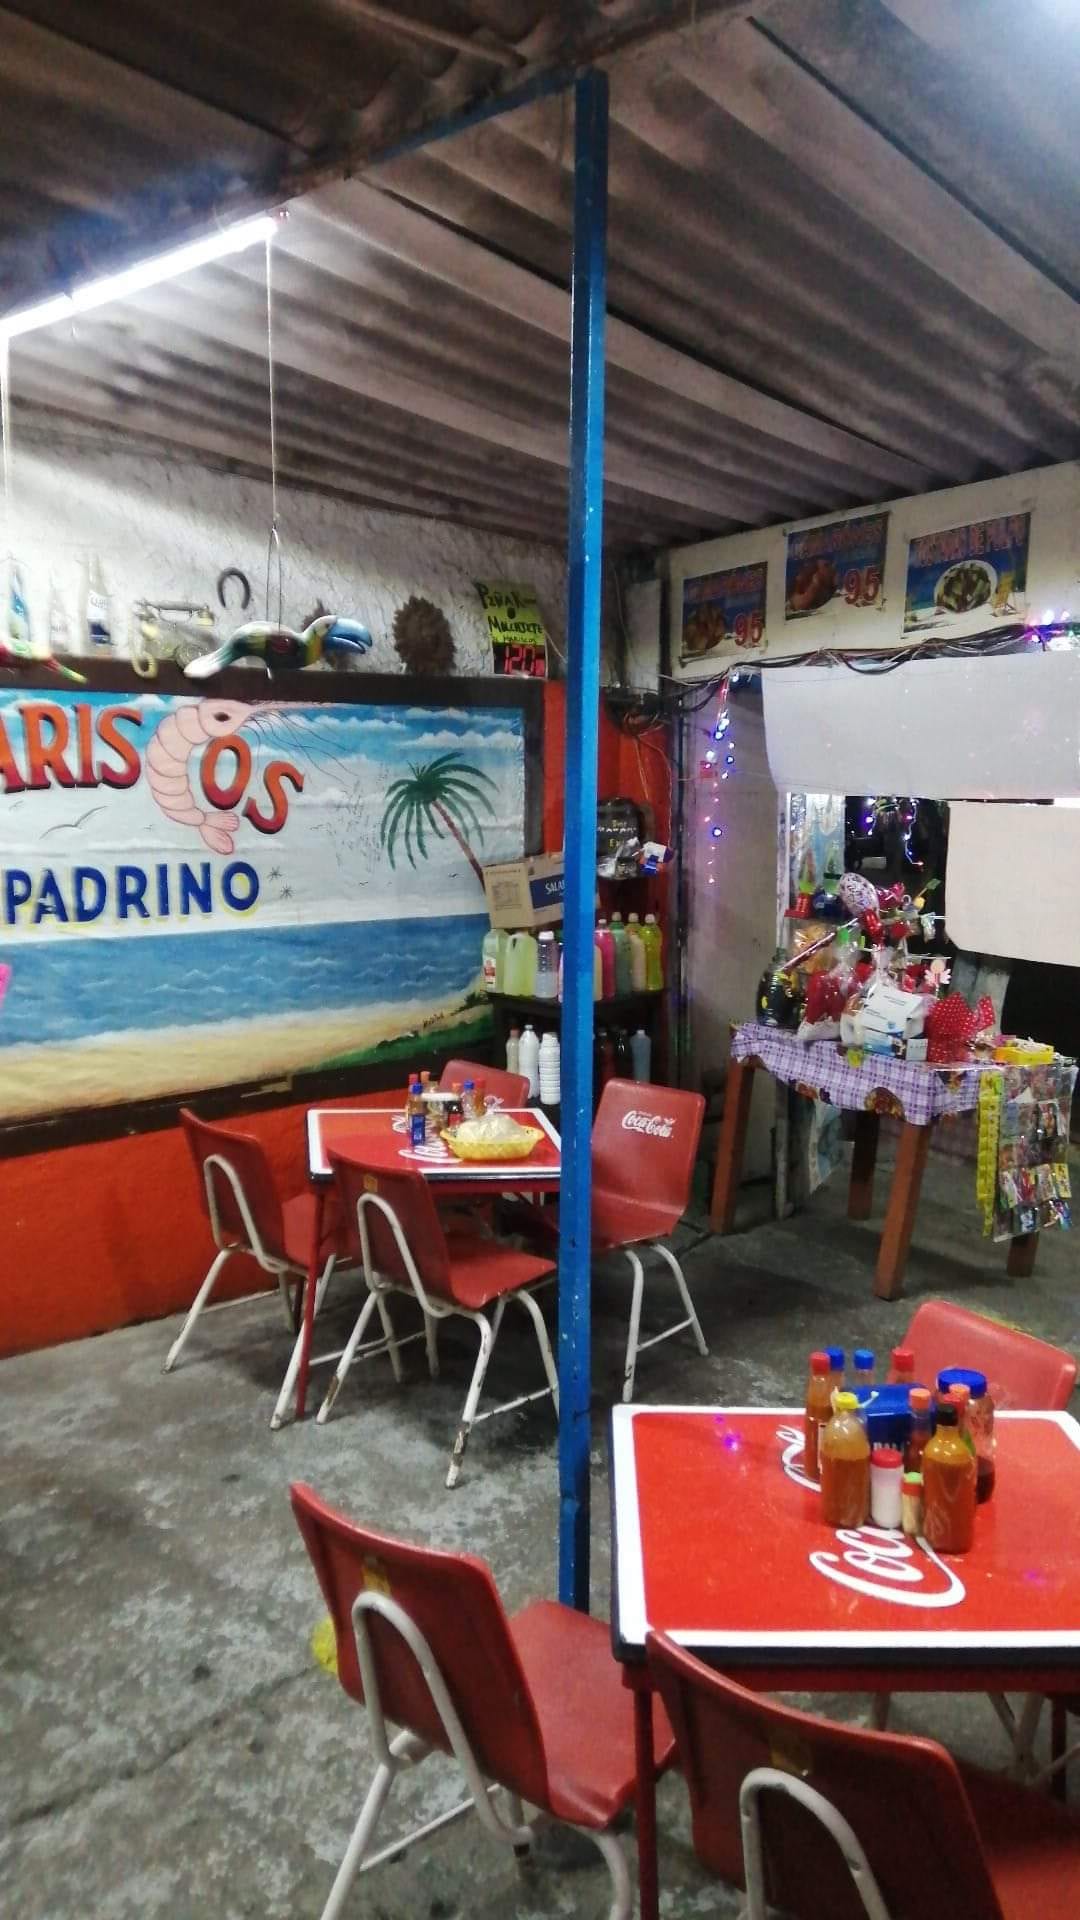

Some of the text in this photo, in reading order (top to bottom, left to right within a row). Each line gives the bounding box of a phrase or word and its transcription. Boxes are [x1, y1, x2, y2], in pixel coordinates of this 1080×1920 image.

[844, 563, 881, 605] 95
[733, 608, 764, 647] 95
[4, 861, 260, 925] PADRINO
[621, 1110, 676, 1138] Coca-Cola
